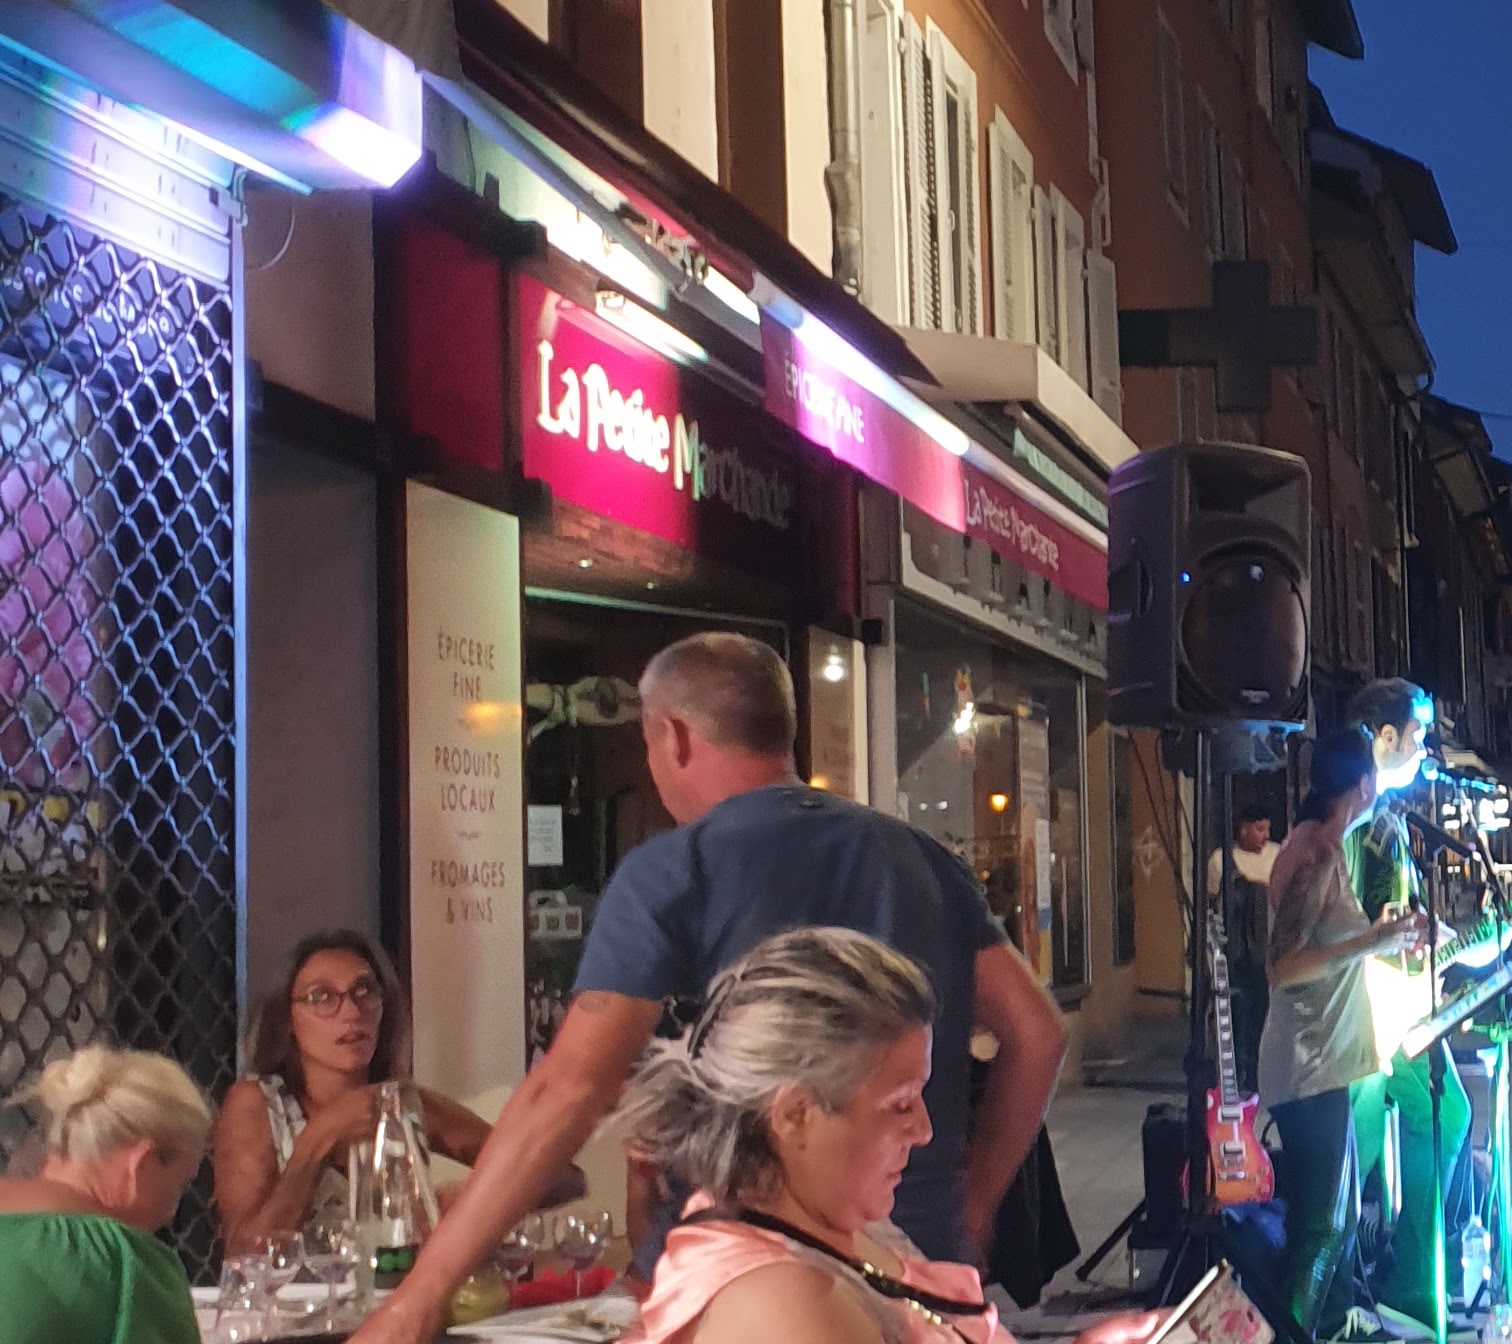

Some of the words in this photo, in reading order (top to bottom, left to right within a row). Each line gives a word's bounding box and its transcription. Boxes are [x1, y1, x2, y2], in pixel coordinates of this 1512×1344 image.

[536, 339, 582, 439] La
[453, 671, 481, 702] FINE
[434, 745, 501, 779] PRODUITS
[440, 783, 495, 813] LOCAUX
[431, 859, 505, 888] FROMAGES
[460, 897, 493, 924] VINS
